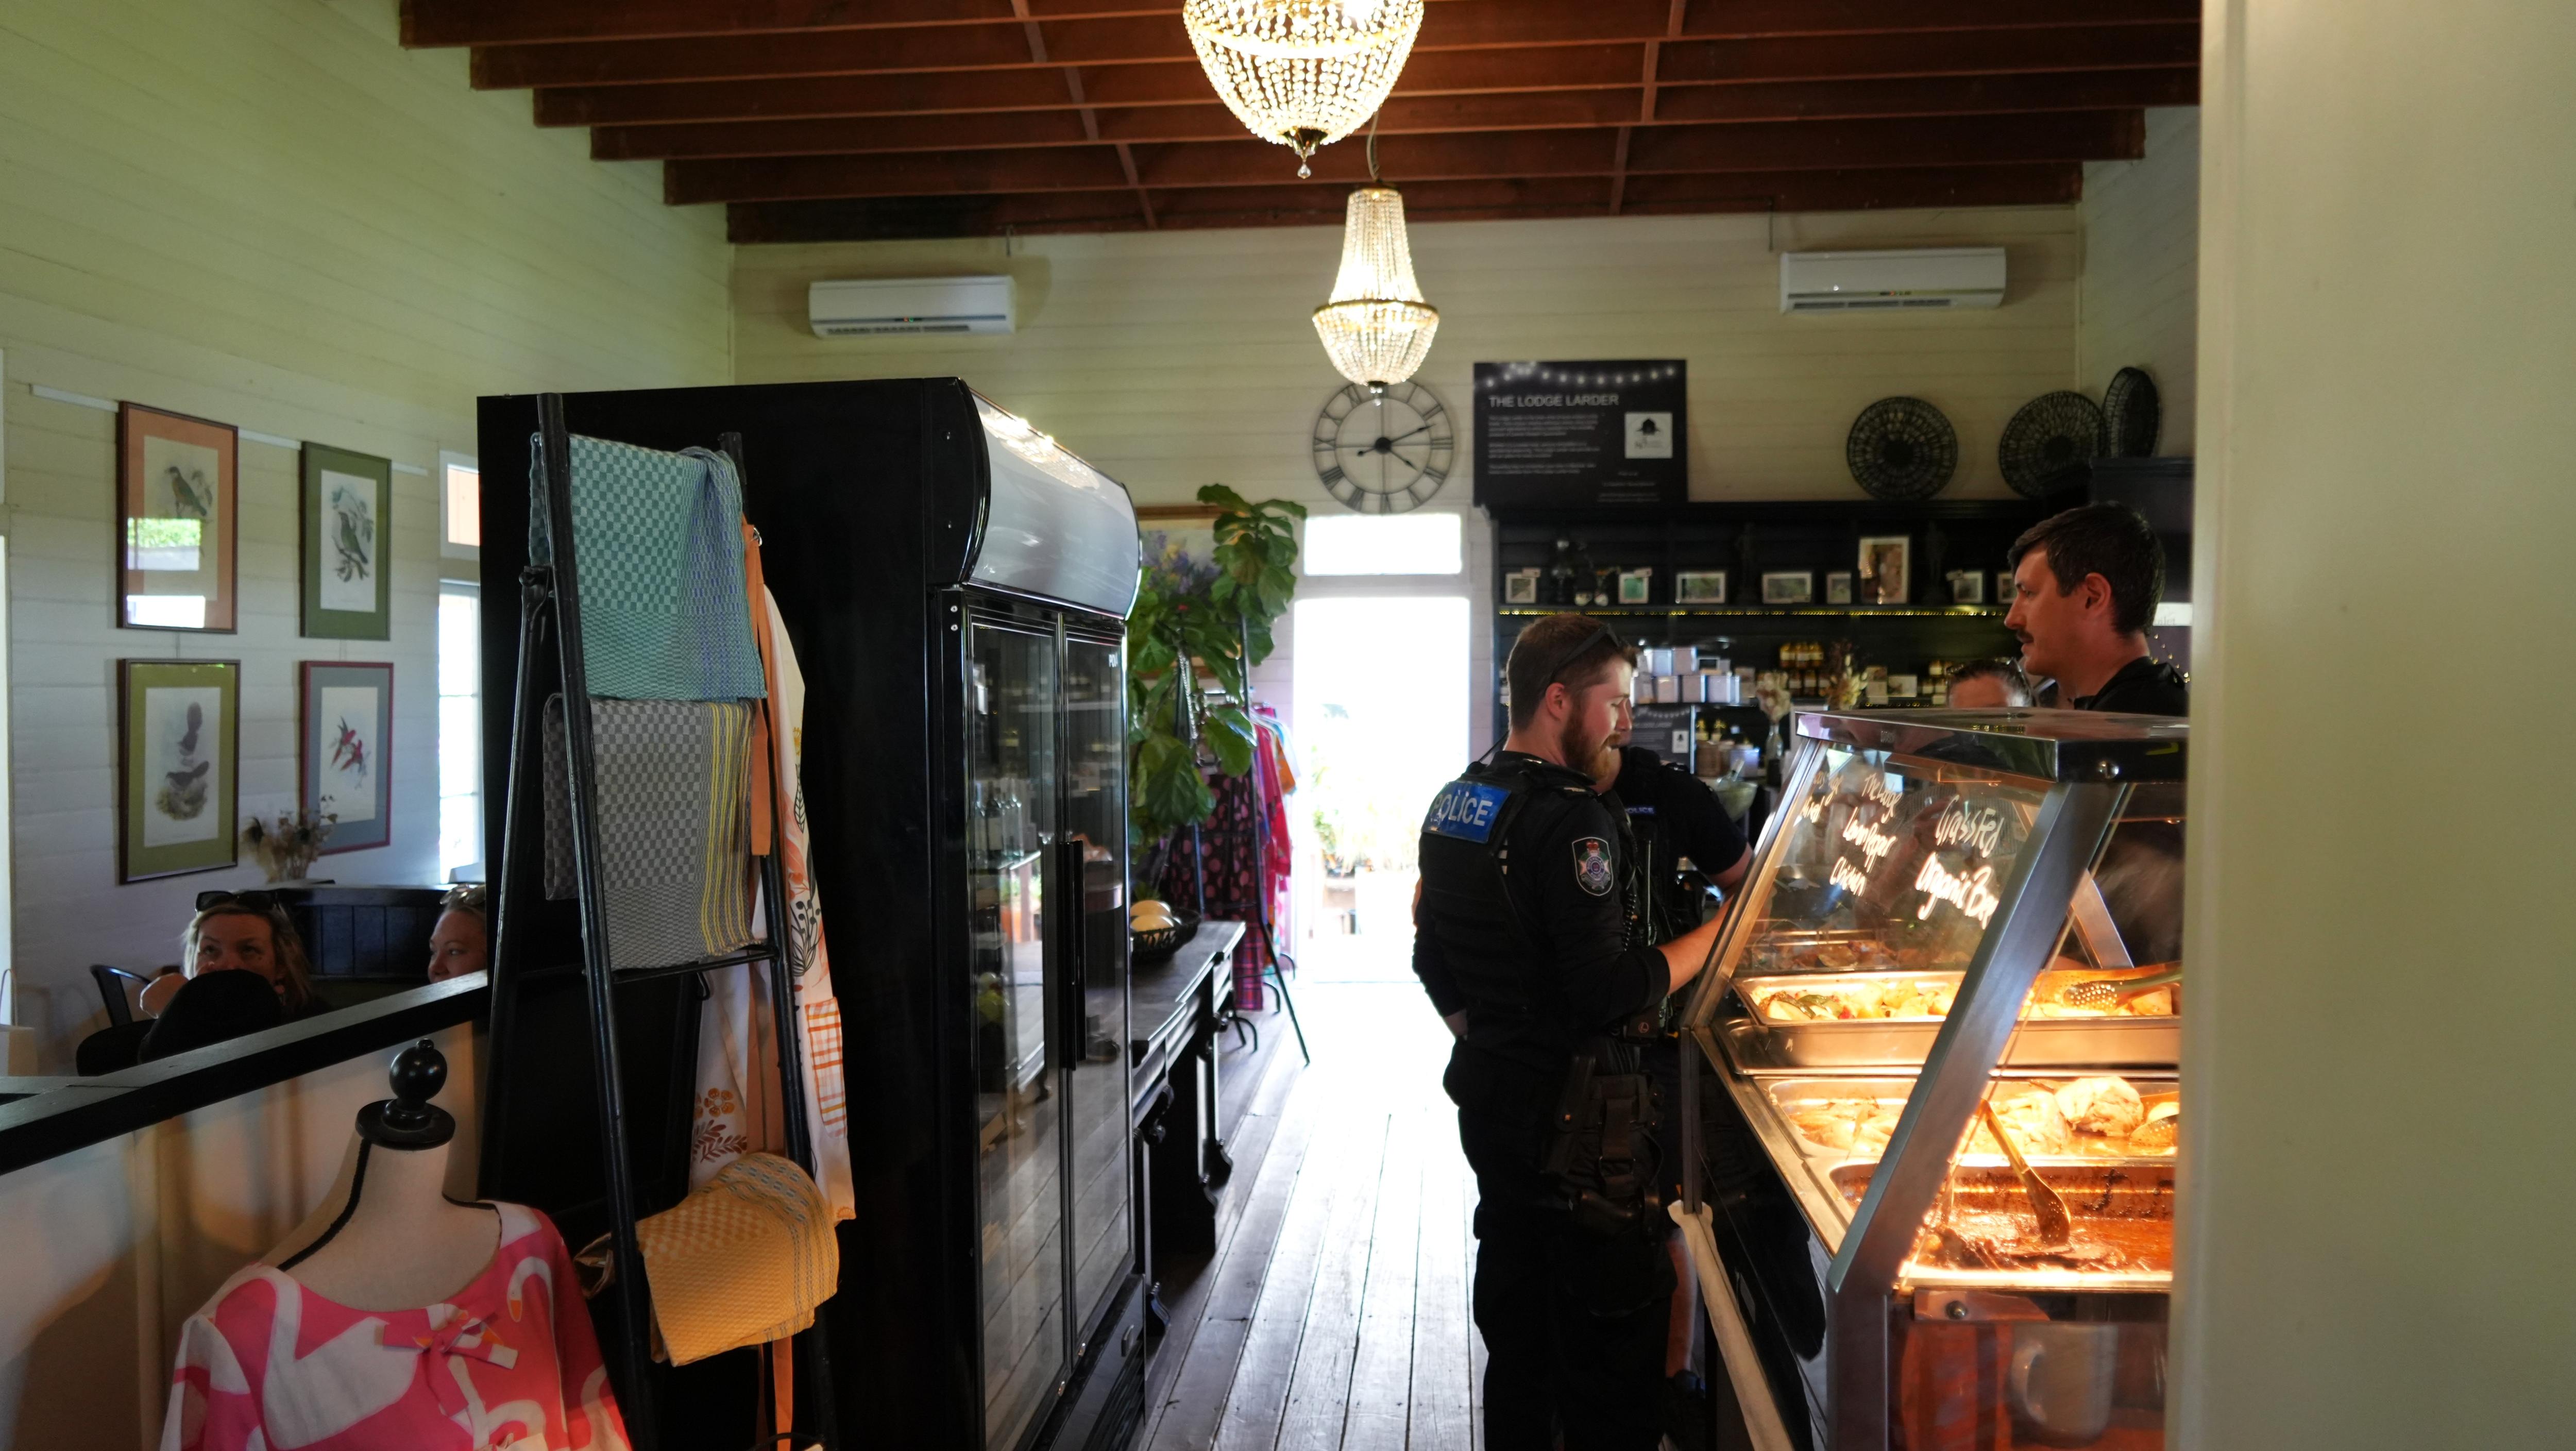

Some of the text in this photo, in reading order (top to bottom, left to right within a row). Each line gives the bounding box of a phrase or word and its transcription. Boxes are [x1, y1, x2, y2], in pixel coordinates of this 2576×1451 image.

[1488, 393, 1619, 408] THE LODGE LARDER
[1430, 794, 1493, 826] POLICE
[1861, 772, 1880, 801] The
[1876, 775, 1903, 823] Lodge
[1936, 795, 2004, 858] Grass Fed
[1915, 852, 1973, 921] Organic
